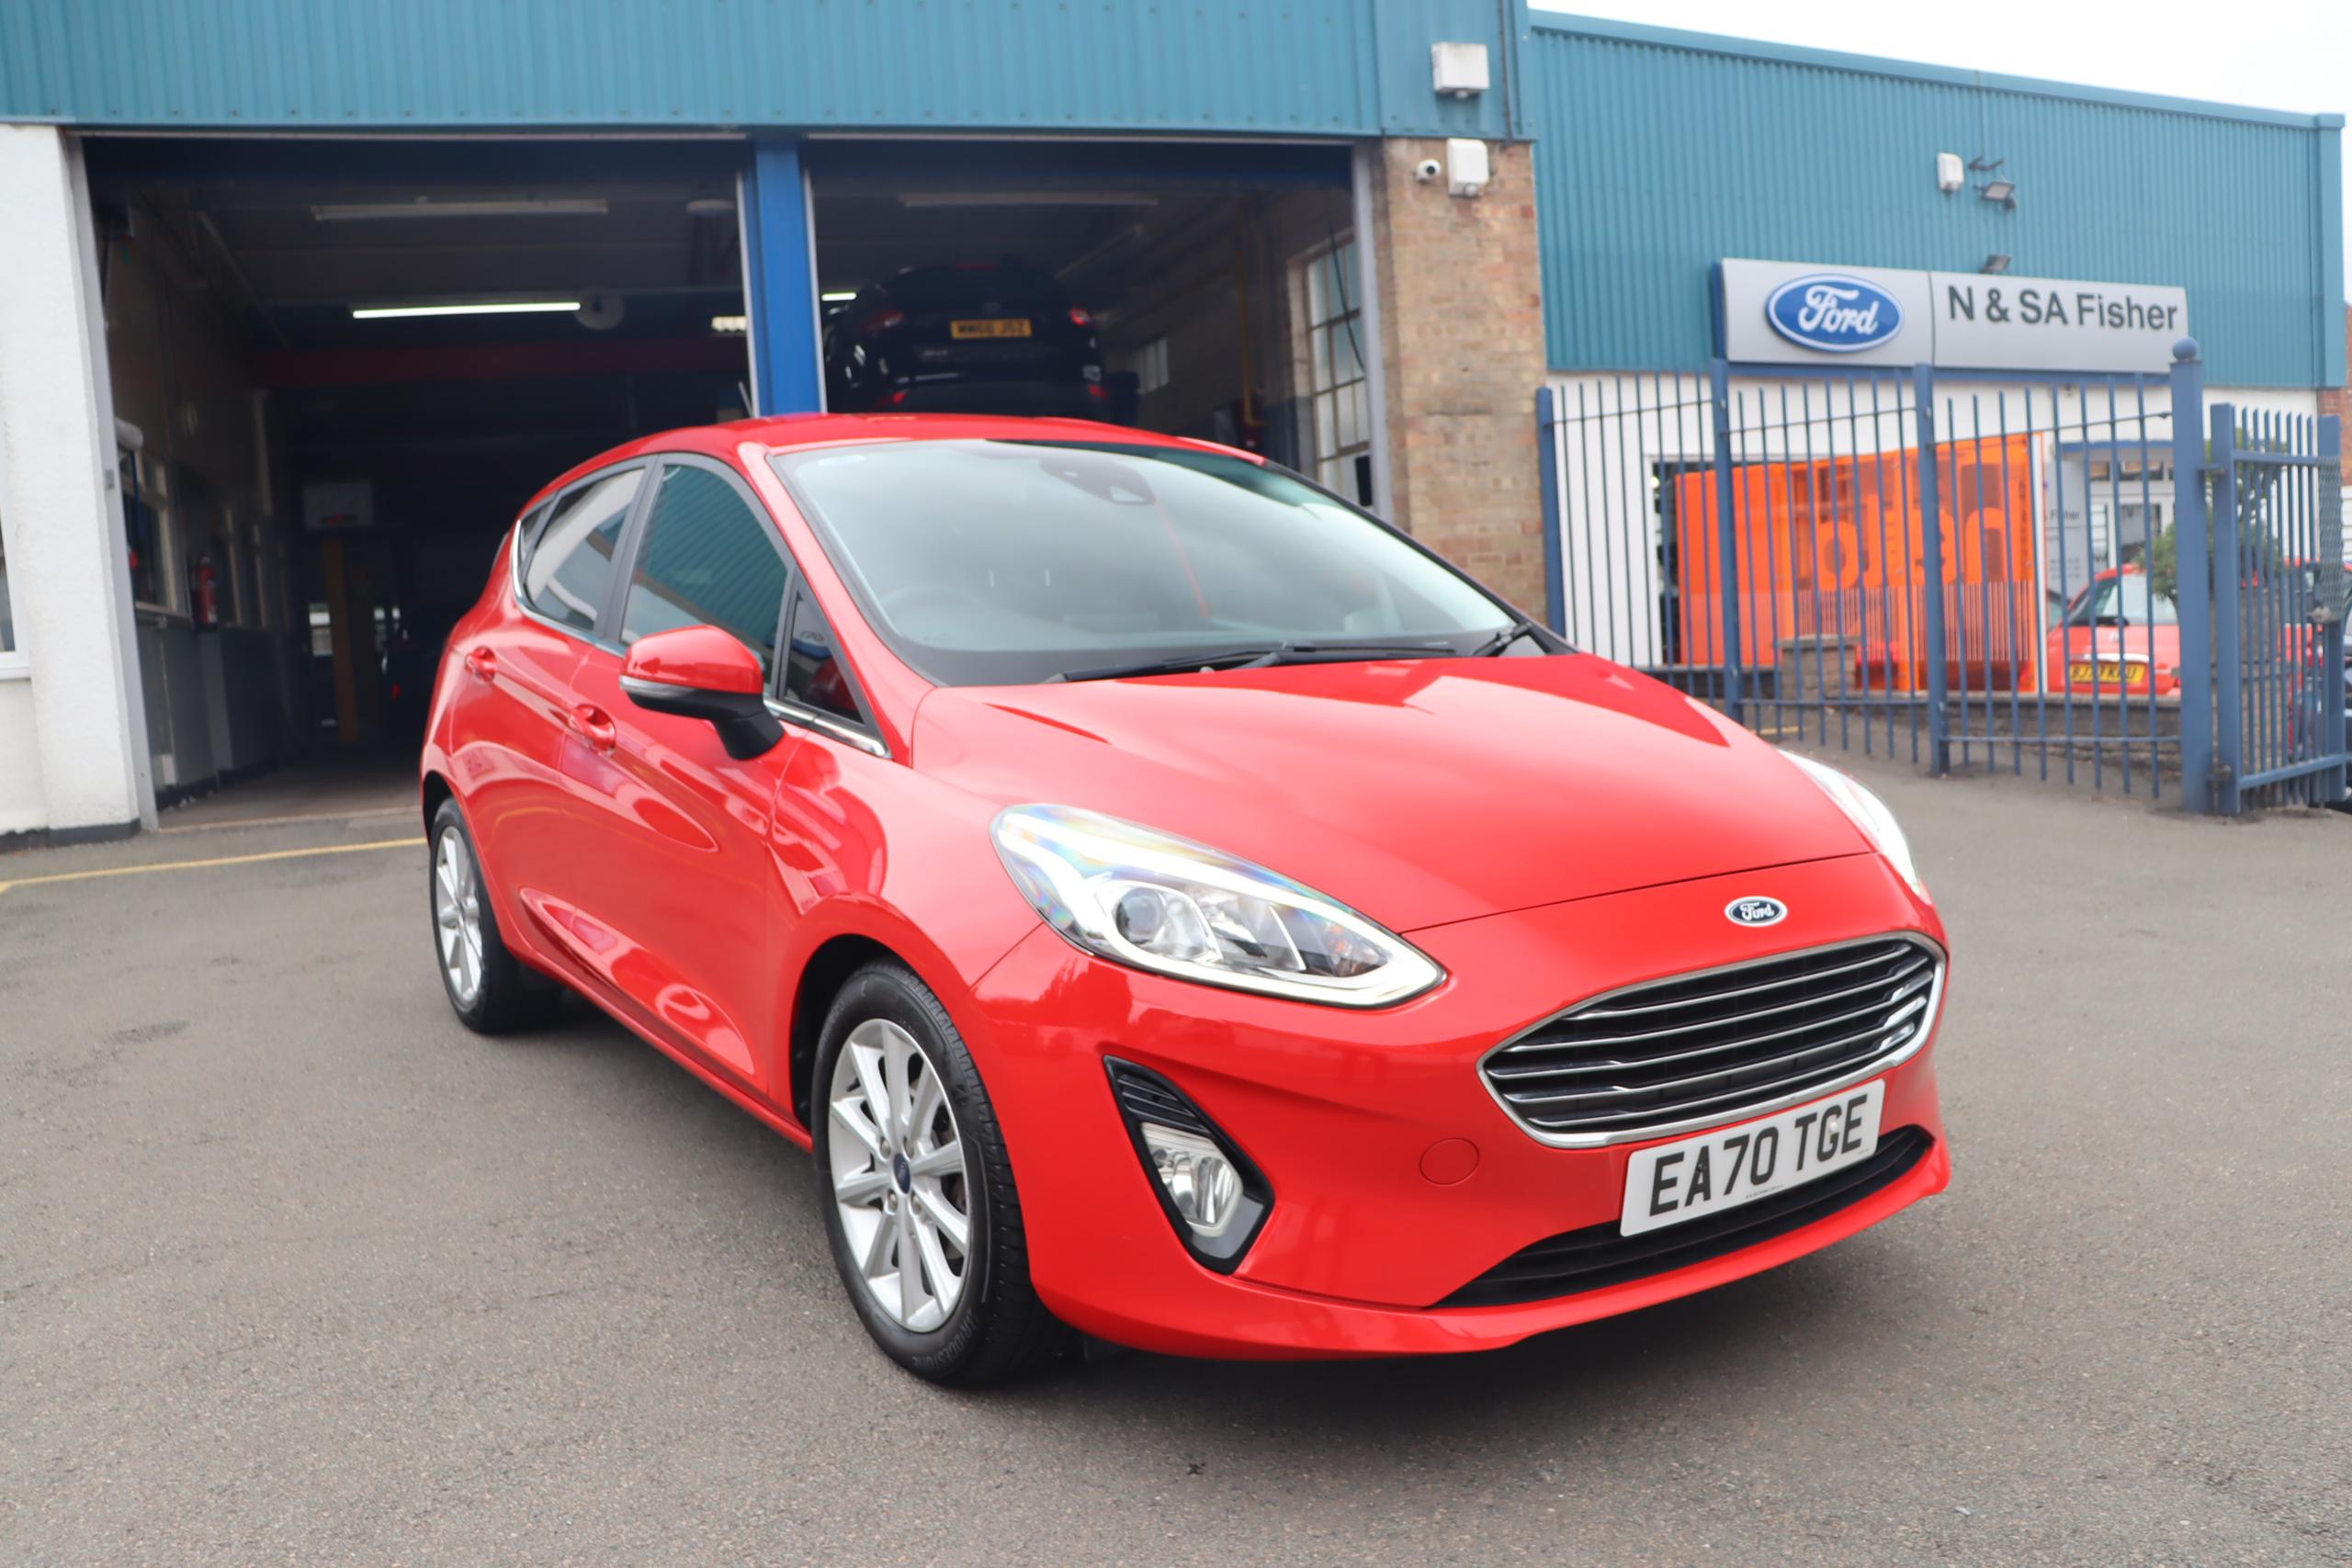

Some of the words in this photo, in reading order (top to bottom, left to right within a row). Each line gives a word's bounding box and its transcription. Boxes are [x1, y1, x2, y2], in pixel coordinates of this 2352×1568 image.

[1798, 284, 1879, 335] Ford
[1948, 285, 1974, 321] N
[1985, 288, 2010, 322] &
[2018, 288, 2068, 325] SA
[2076, 292, 2177, 331] Fisher
[1739, 901, 1775, 921] Ford
[1649, 1127, 1779, 1216] EA70
[1794, 1094, 1869, 1172] TGE
